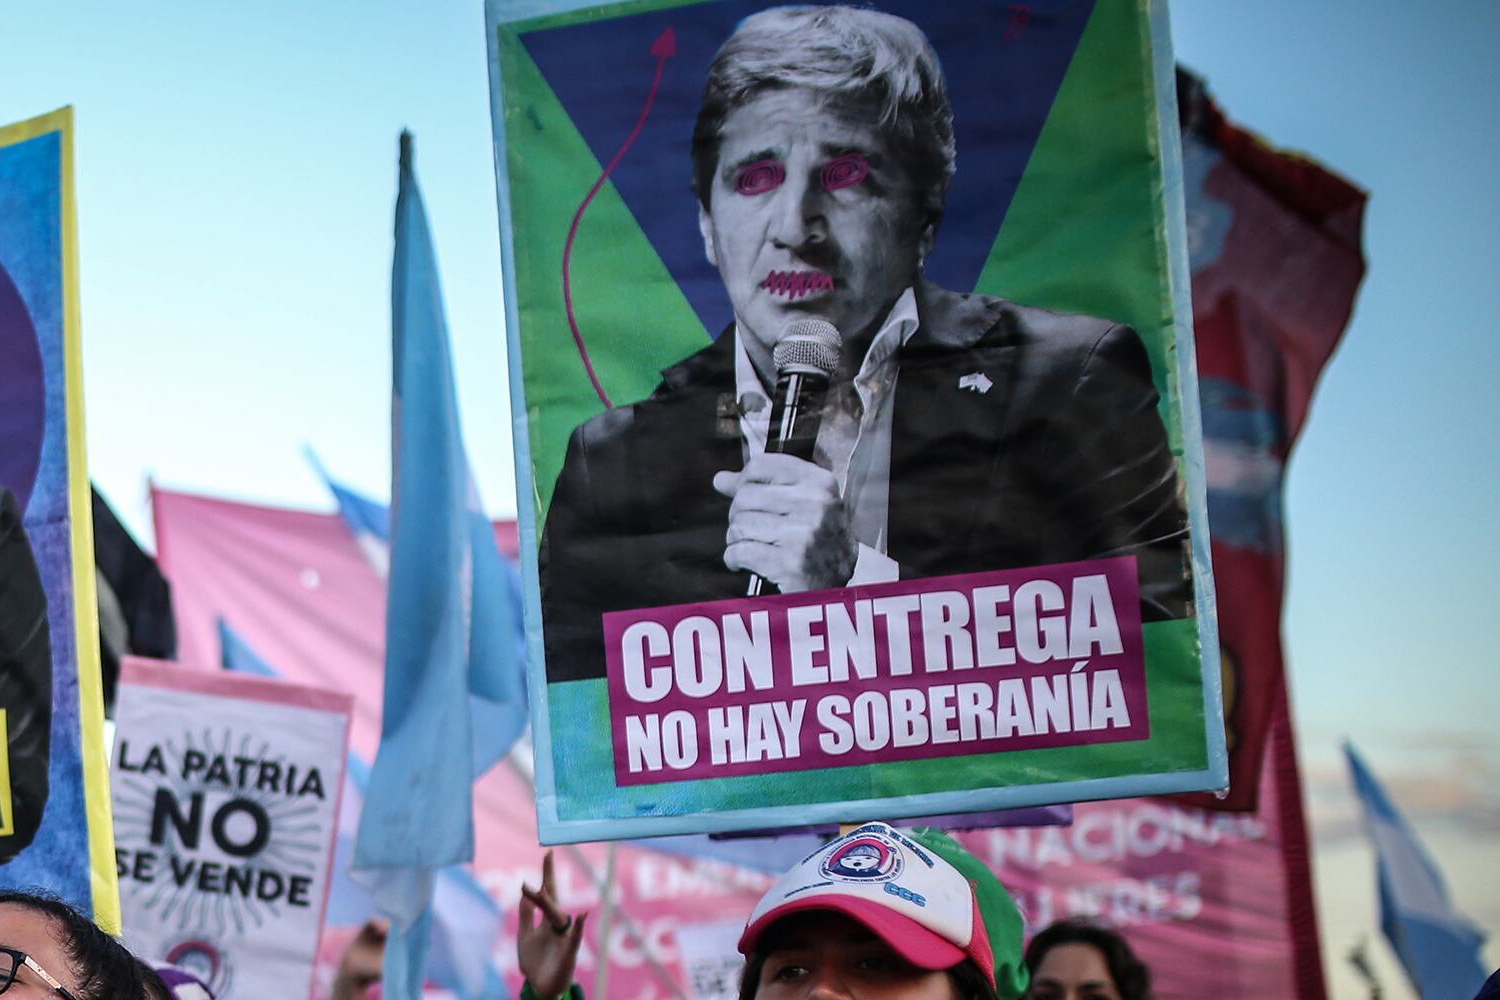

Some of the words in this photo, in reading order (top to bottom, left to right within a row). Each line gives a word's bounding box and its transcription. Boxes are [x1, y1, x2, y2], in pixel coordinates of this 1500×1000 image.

[621, 609, 774, 703] CON
[787, 574, 1125, 687] ENTREGA
[625, 709, 699, 773] NO
[707, 698, 808, 766] HAY
[816, 660, 1132, 755] SOBERANÍA
[118, 740, 167, 776] LA
[181, 749, 326, 800] PATRIA
[150, 786, 271, 859] NO
[114, 846, 157, 883] SE
[170, 856, 314, 907] VENDE
[884, 882, 926, 907] CCC
